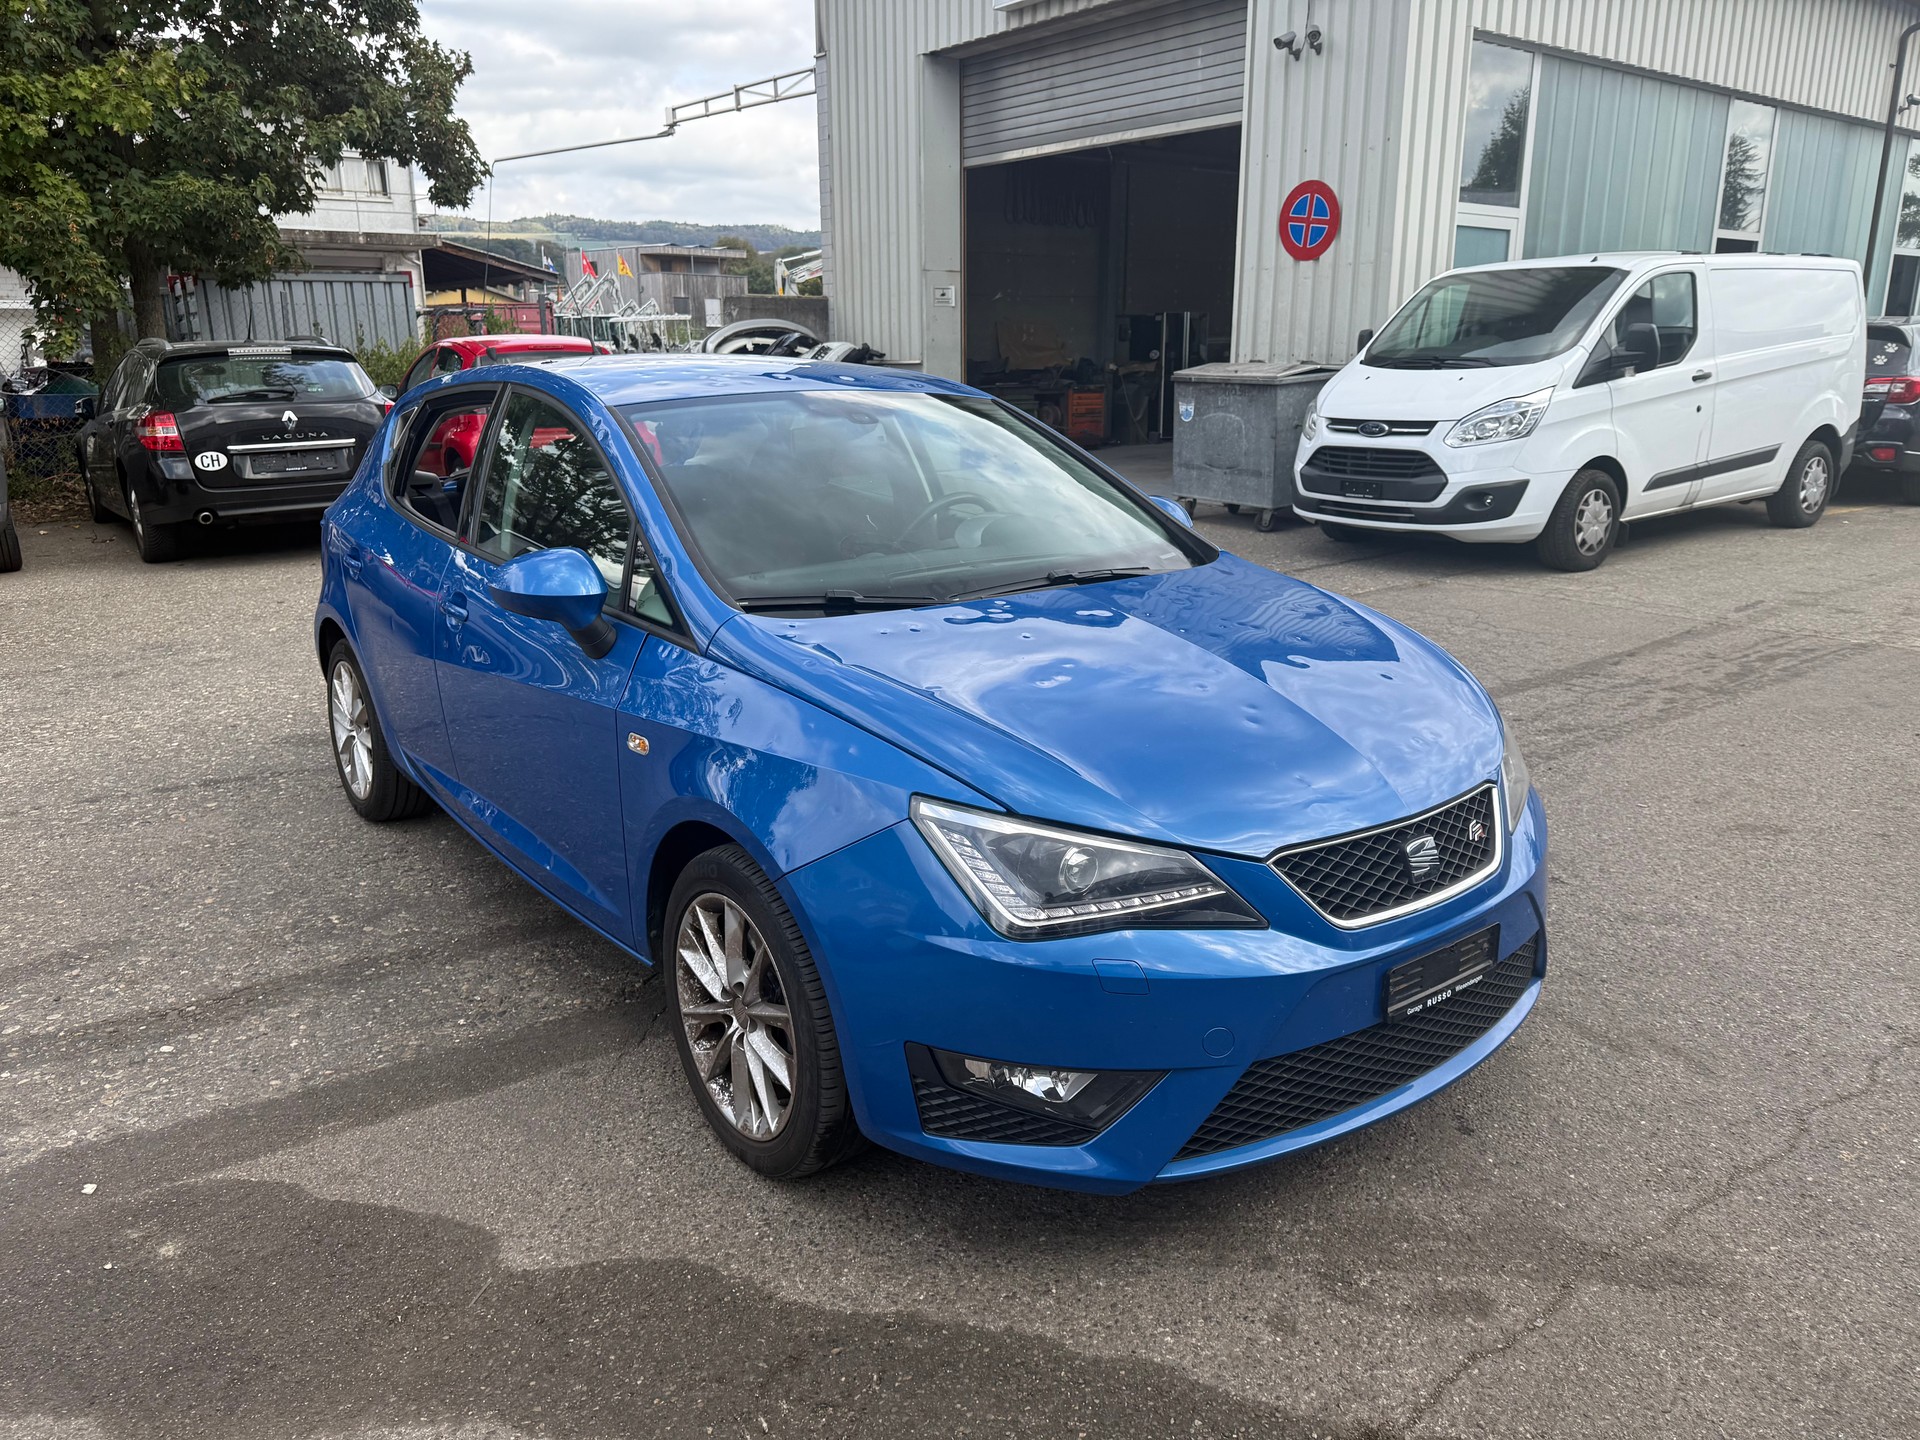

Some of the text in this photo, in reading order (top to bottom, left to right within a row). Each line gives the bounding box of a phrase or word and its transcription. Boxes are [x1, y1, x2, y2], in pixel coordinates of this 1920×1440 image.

[261, 431, 329, 441] LAGUNA
[200, 455, 221, 469] CH
[1406, 1004, 1423, 1015] Garage
[1426, 989, 1452, 1008] RUSSO
